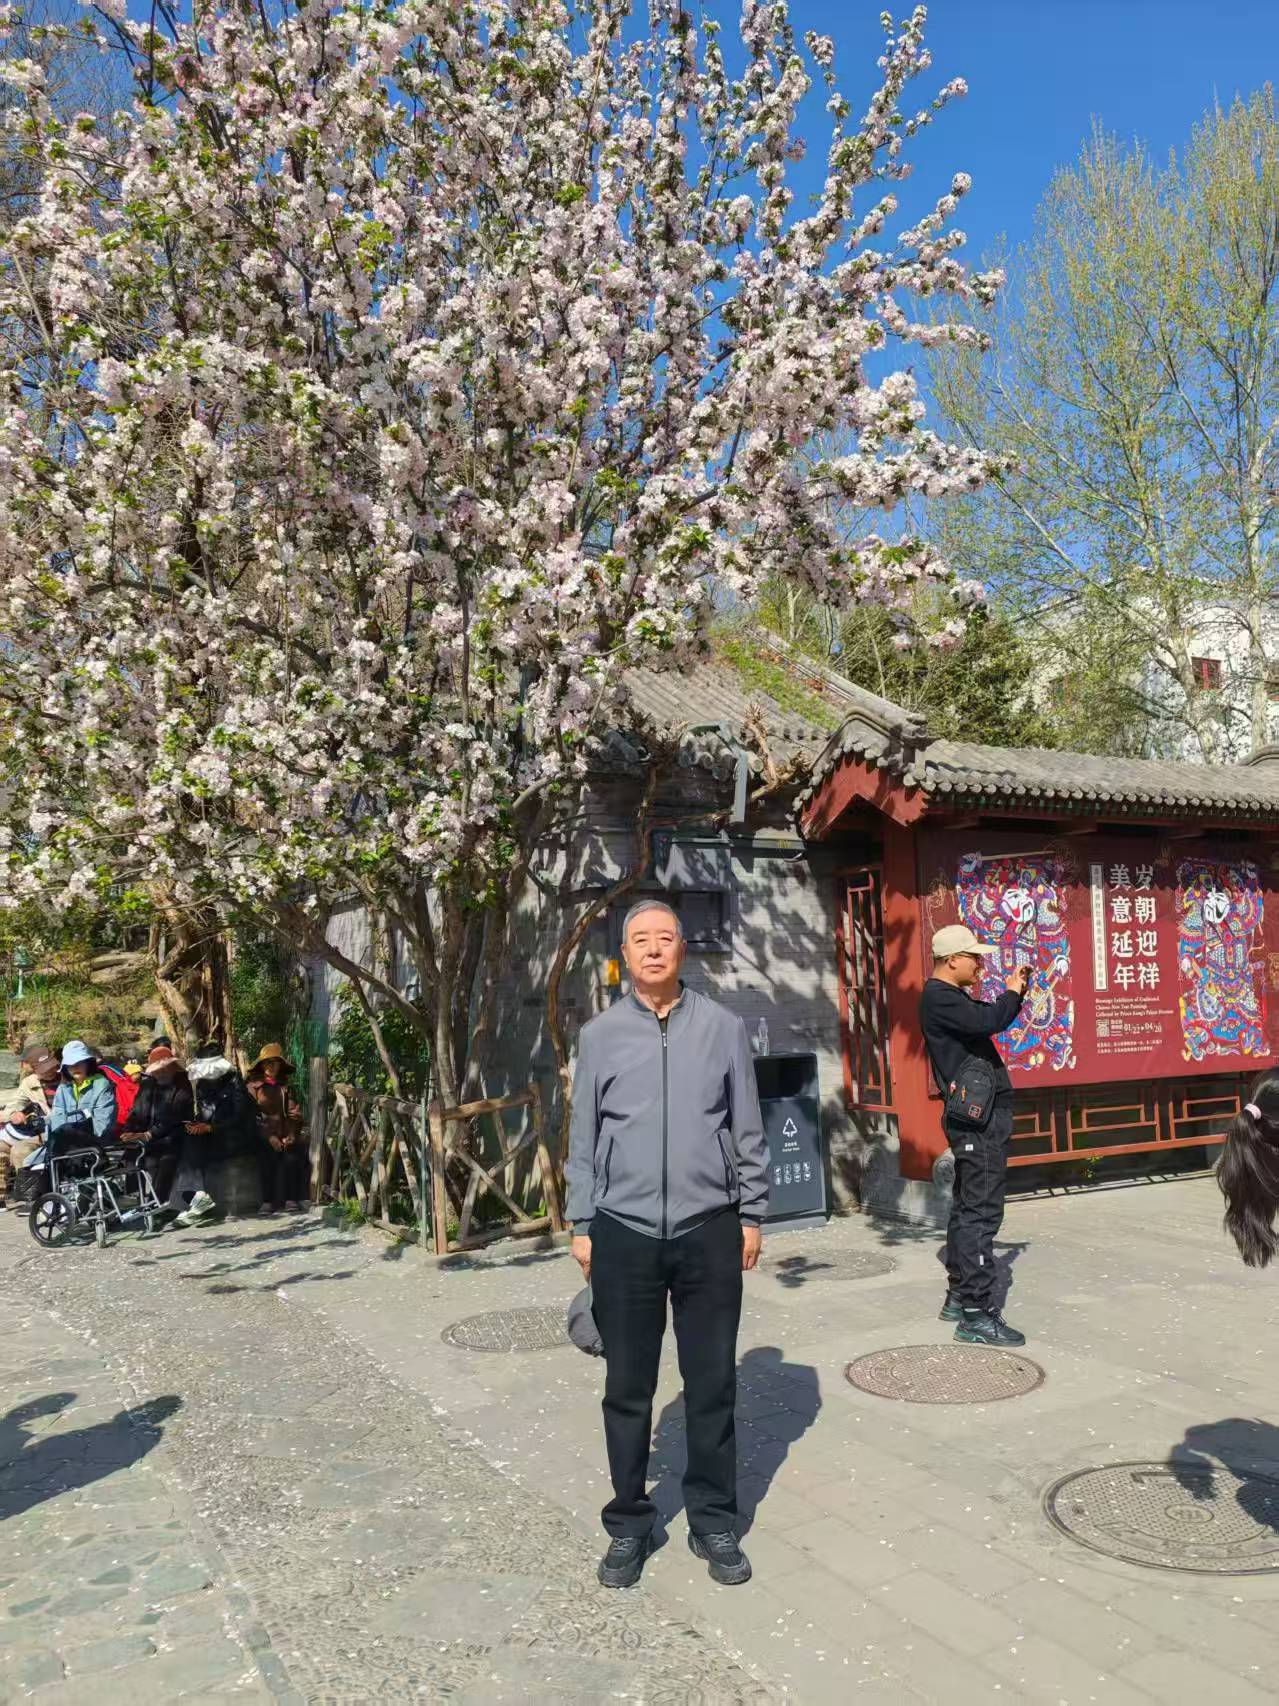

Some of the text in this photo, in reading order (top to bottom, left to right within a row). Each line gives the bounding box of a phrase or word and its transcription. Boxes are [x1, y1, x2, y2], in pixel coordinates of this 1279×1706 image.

[1109, 864, 1136, 991] 美意延年
[1134, 864, 1160, 990] 岁朝迎祥
